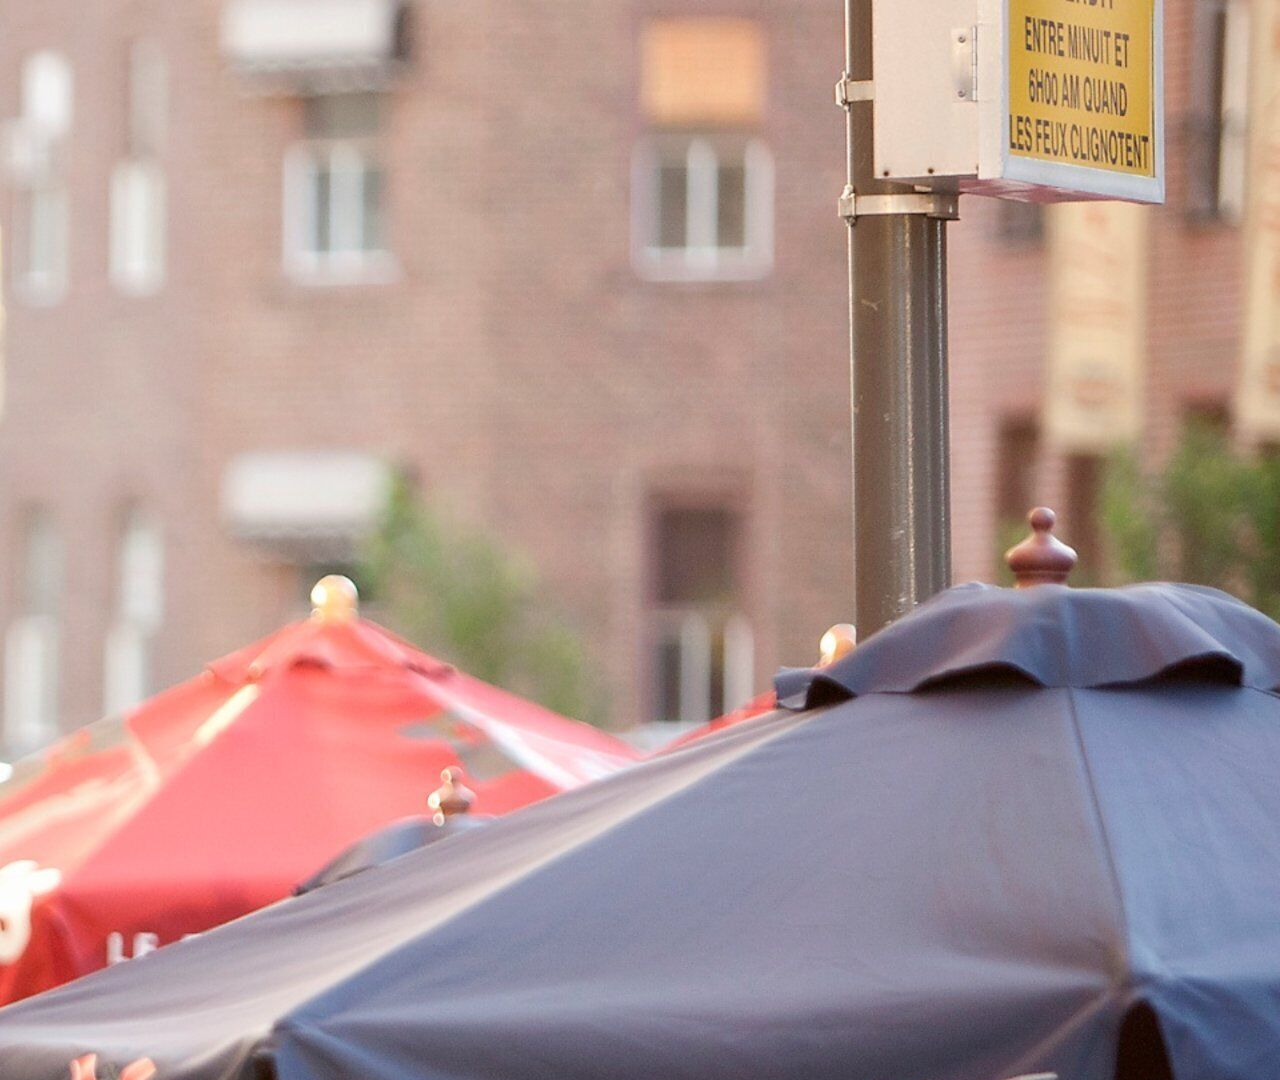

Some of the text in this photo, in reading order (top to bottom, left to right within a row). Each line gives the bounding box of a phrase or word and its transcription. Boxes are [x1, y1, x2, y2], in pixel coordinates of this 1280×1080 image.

[1025, 16, 1130, 68] ENTRE MINUIT ET
[1028, 68, 1128, 117] 6H00 AM QUAND
[1009, 114, 1149, 170] LES FEUX CLIGNOTENT
